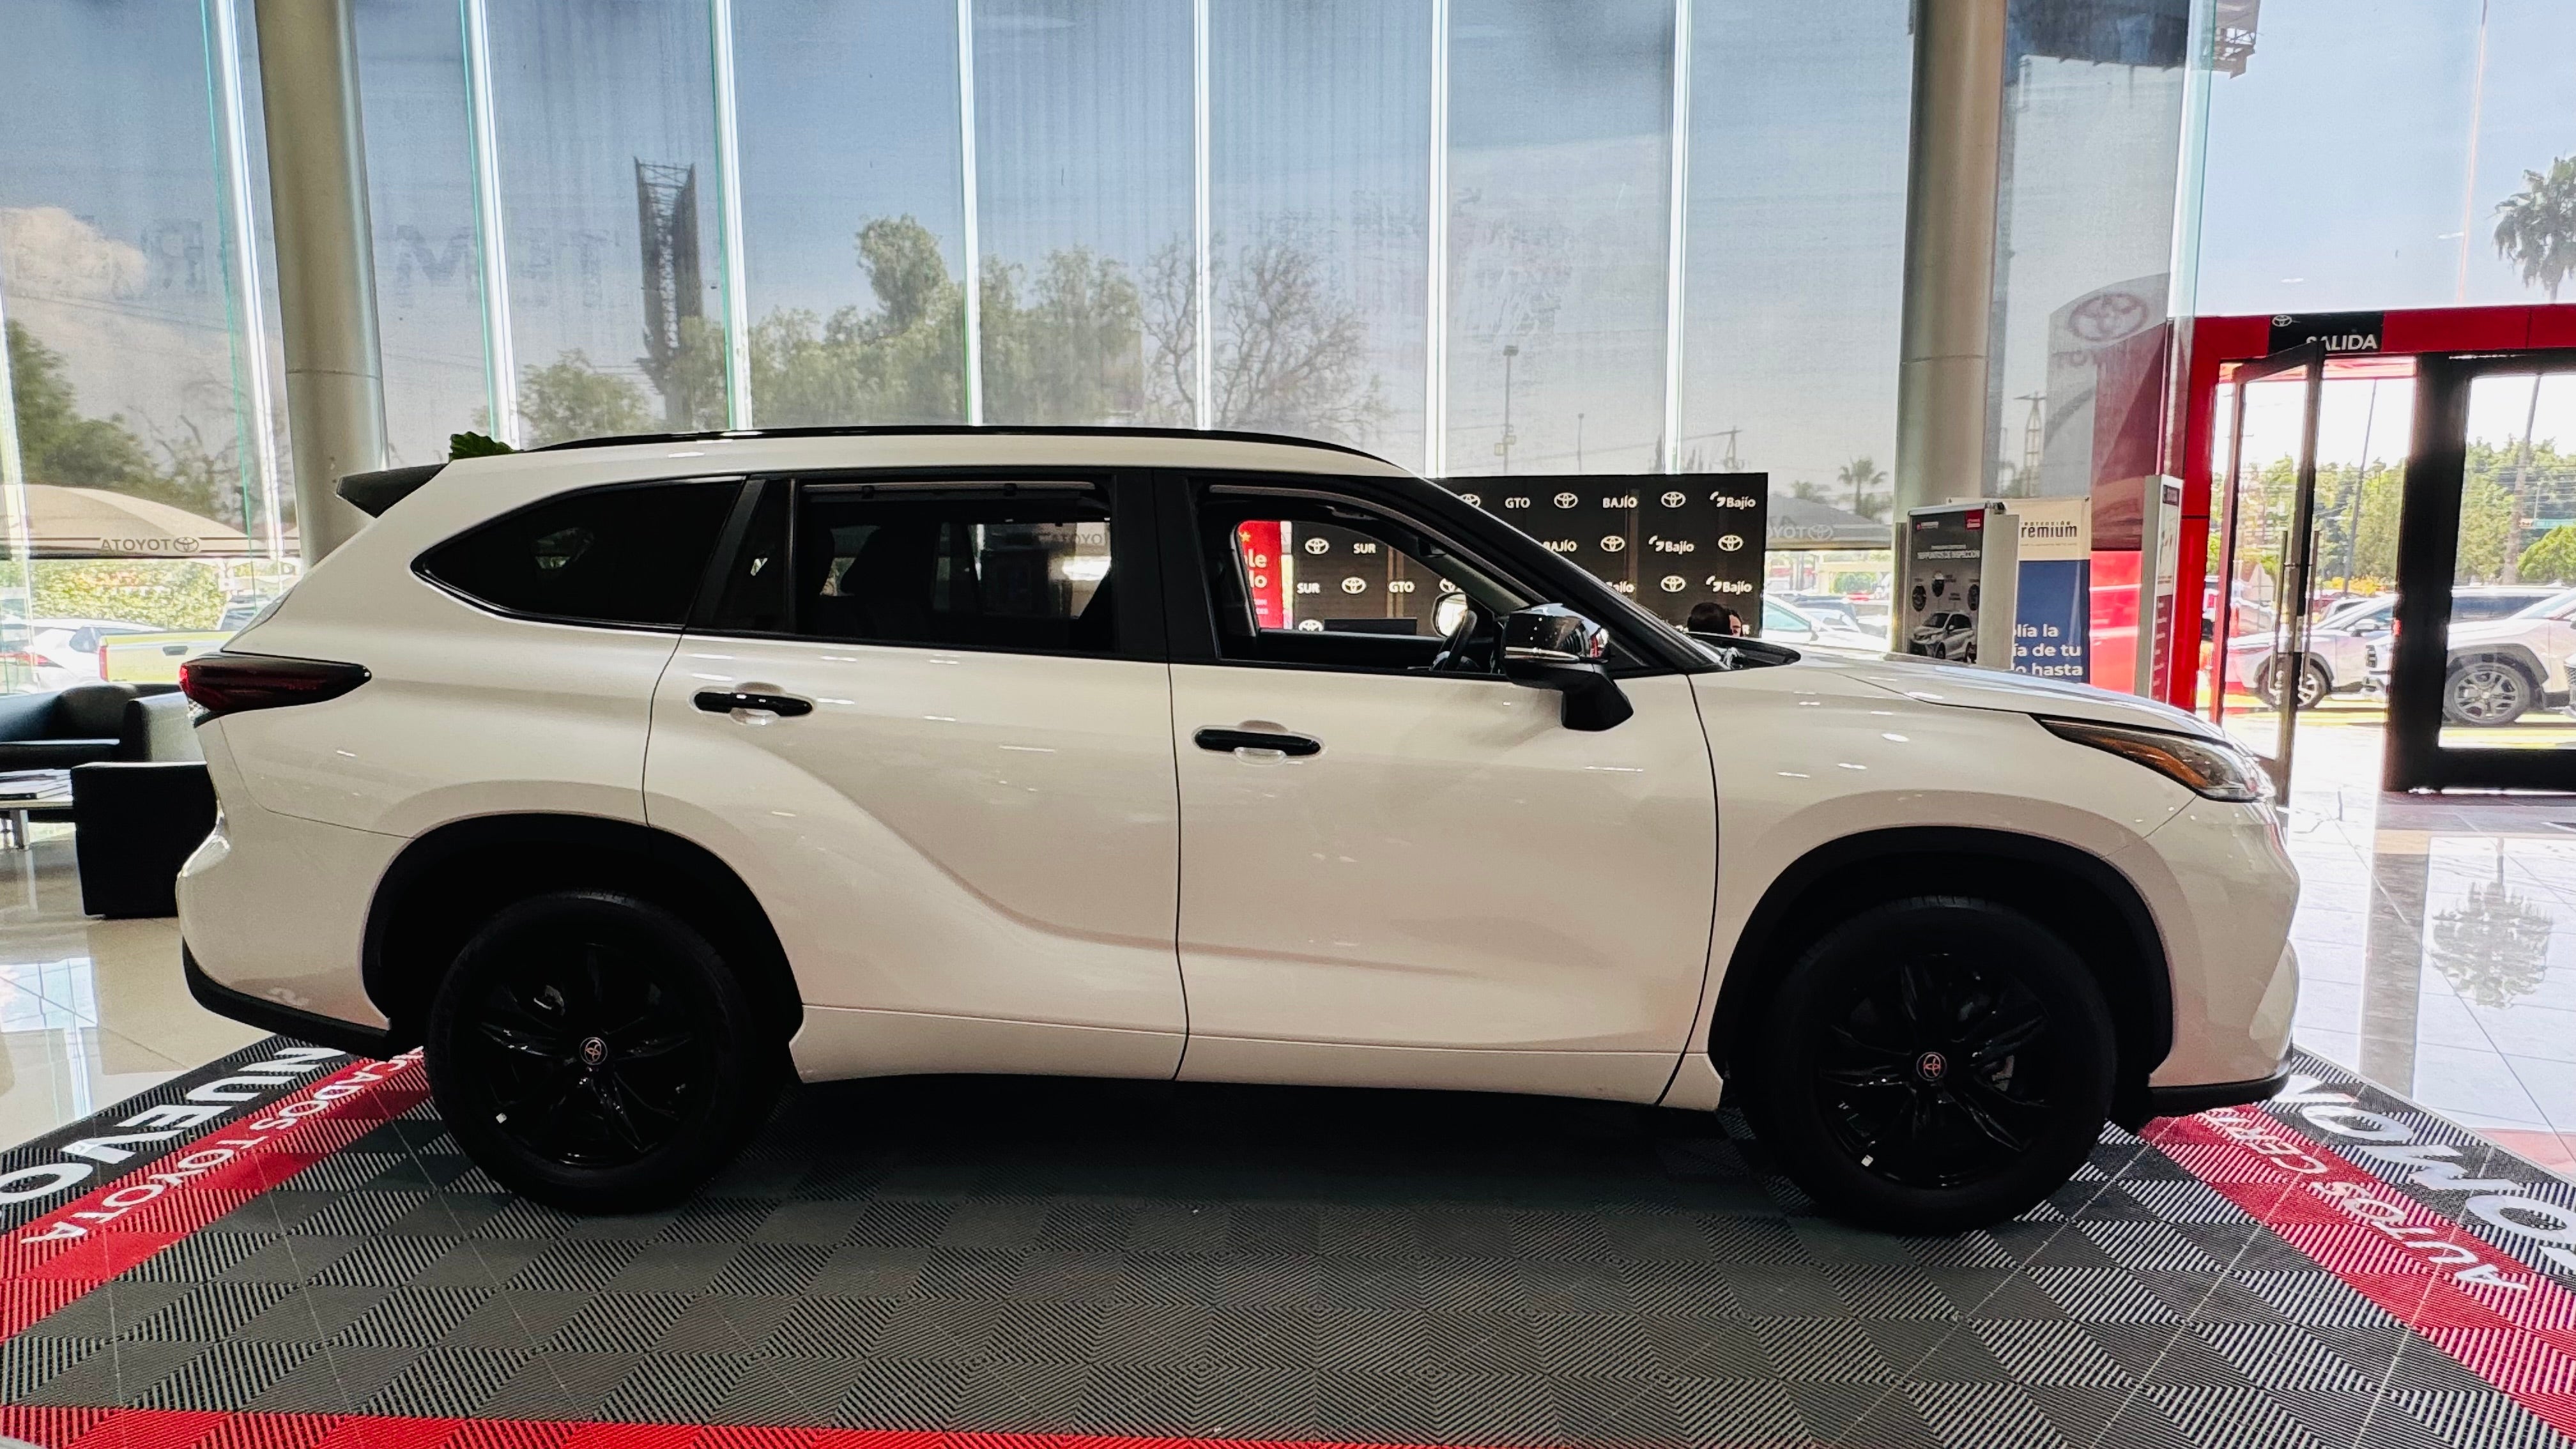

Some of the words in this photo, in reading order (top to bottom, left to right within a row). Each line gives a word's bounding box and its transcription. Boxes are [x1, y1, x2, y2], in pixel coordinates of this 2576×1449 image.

[1505, 496, 1531, 509] GTO
[1602, 494, 1638, 509] BAJÍO
[1726, 496, 1756, 510] Bajío
[1353, 543, 1376, 555] SUR
[1665, 540, 1694, 555] Bajío
[1296, 583, 1321, 594] SUR
[1388, 581, 1415, 593] GTO
[1722, 581, 1752, 595] Bajío
[2043, 624, 2059, 638] la
[2032, 643, 2057, 657] de
[2060, 644, 2082, 657] tu
[2032, 662, 2083, 677] hasta
[0, 1047, 347, 1205] NUEVO
[21, 1135, 269, 1245] TOYOTA
[2310, 1181, 2530, 1291] AUTOS
